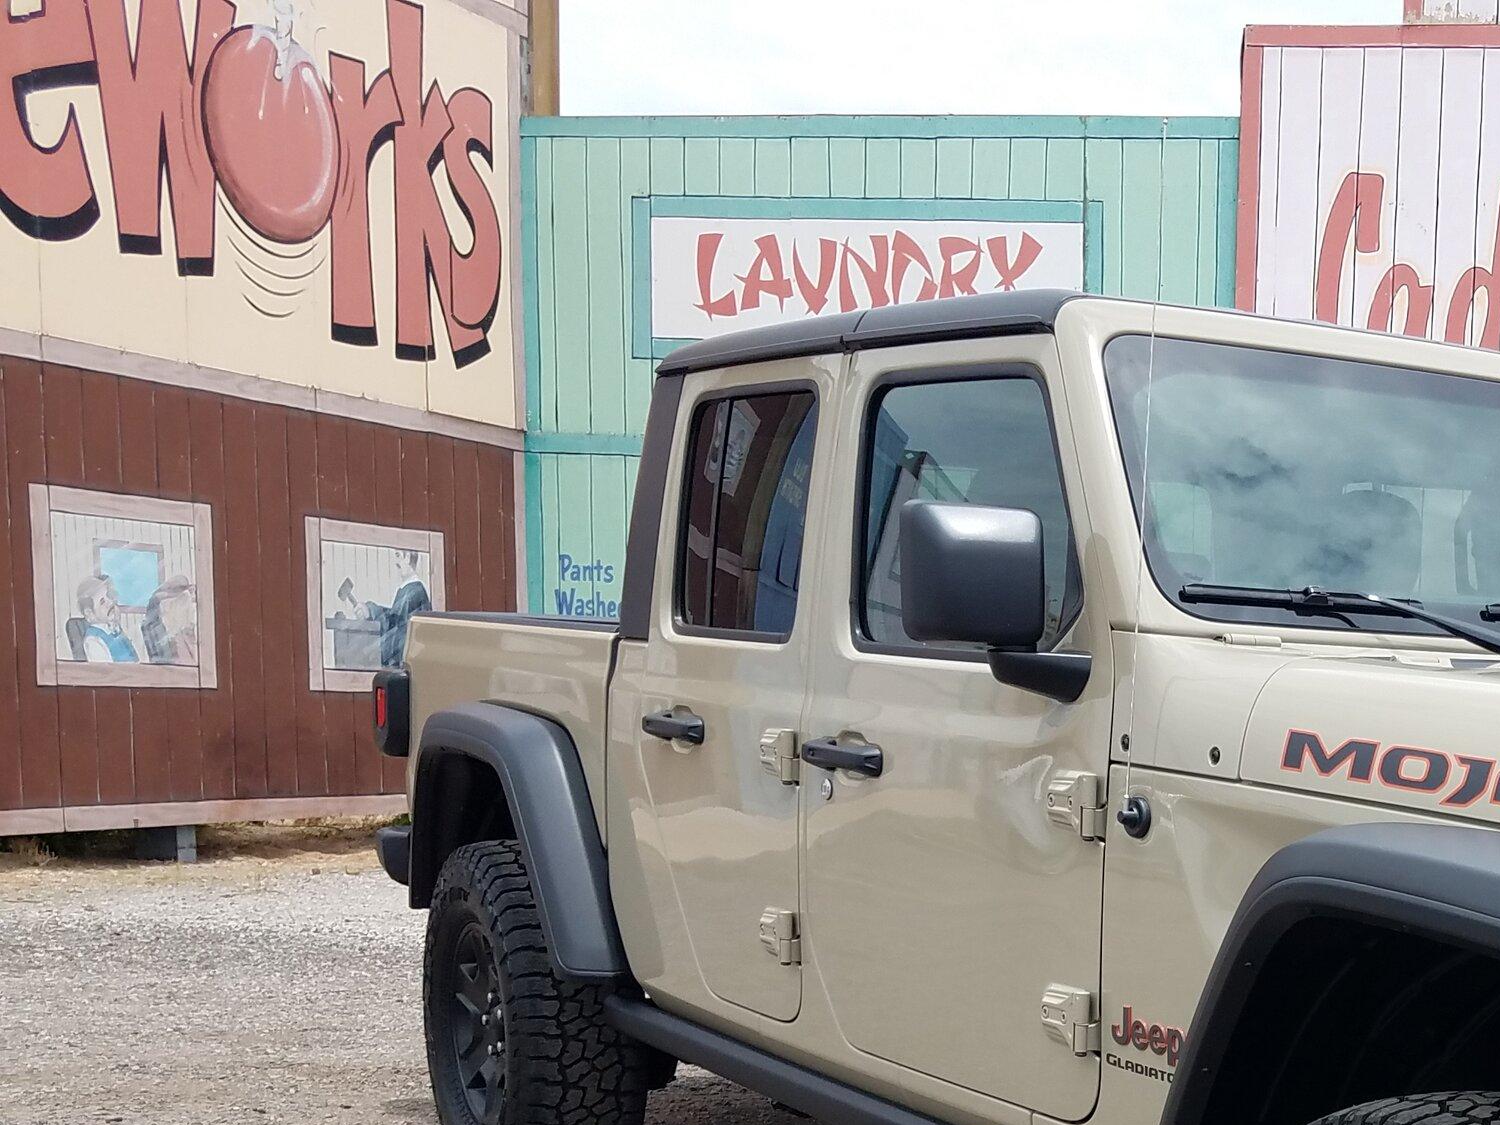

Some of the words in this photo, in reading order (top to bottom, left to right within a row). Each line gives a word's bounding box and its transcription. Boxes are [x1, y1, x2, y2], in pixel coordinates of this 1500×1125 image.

[692, 230, 1043, 321] LAUNDRY
[558, 553, 615, 584] Pants
[554, 587, 621, 618] Washe
[1111, 1004, 1186, 1068] Jeep
